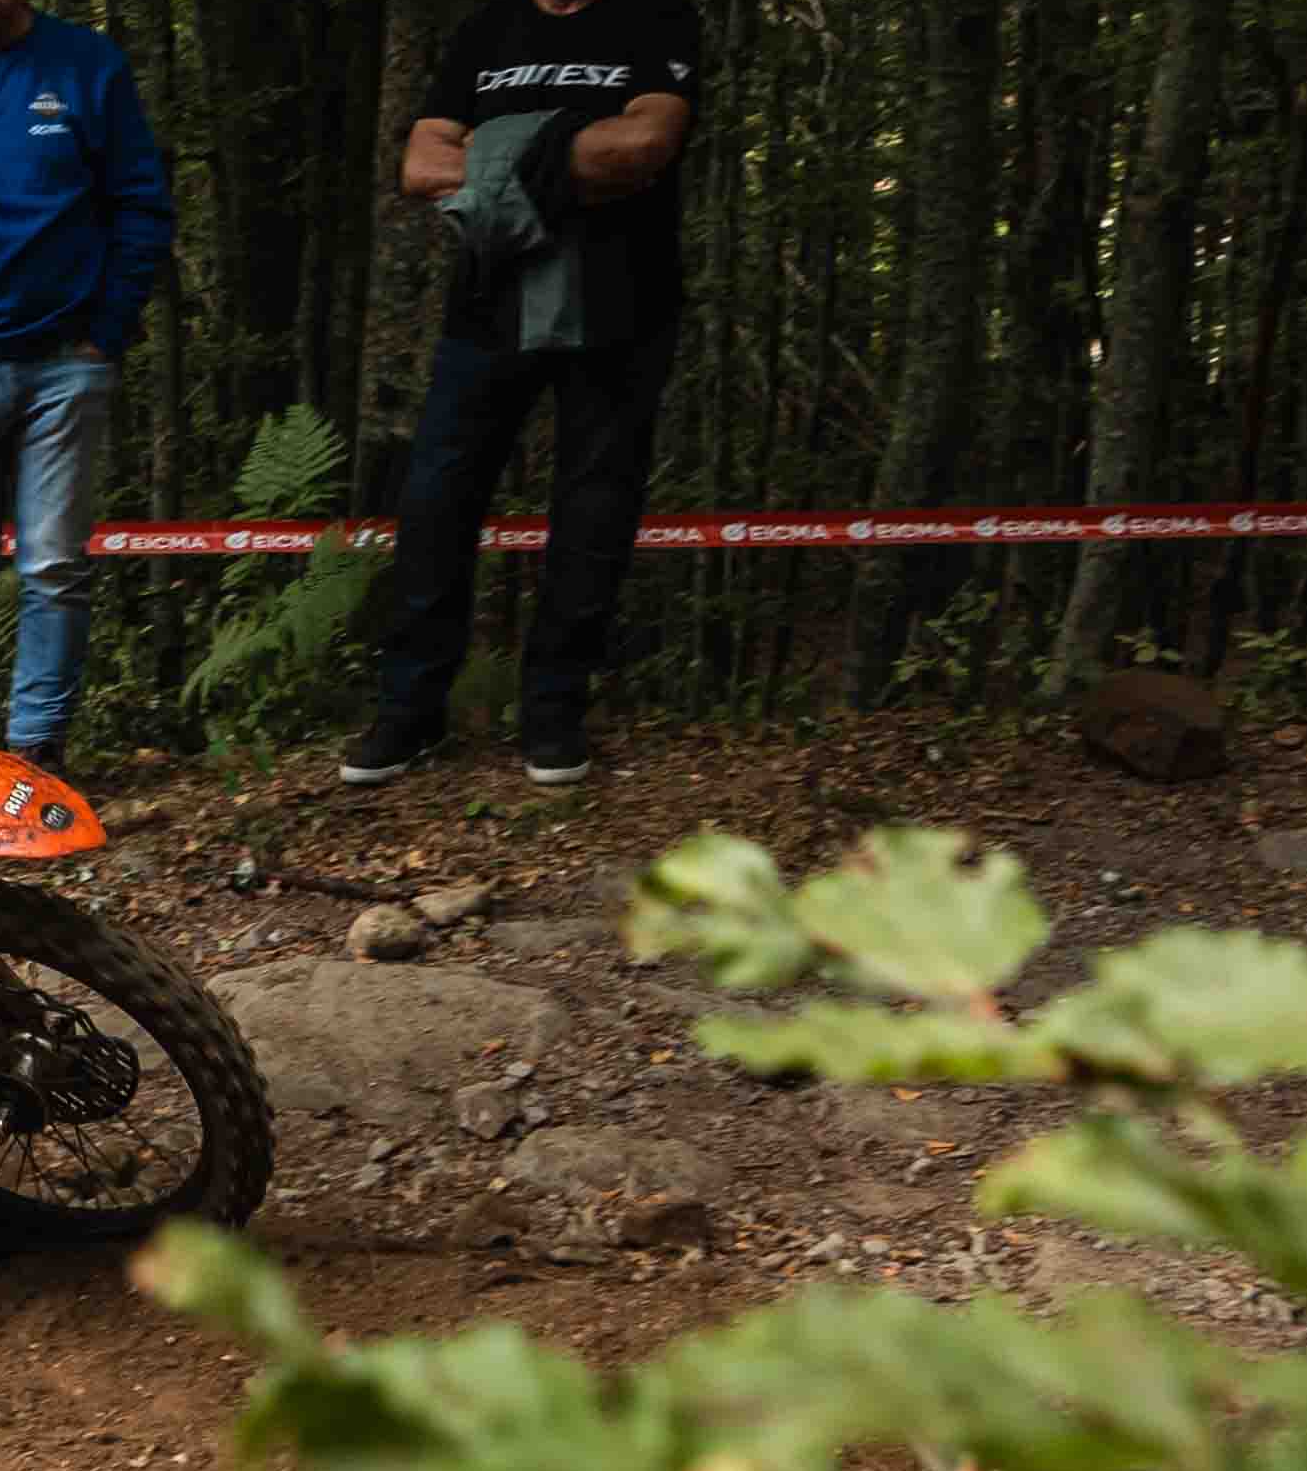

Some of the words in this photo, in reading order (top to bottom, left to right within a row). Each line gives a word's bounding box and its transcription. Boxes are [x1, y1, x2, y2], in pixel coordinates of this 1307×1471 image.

[475, 63, 633, 93] DAINESE
[749, 523, 828, 541] EICMA
[875, 522, 956, 539] EICMA
[1001, 519, 1084, 537] EICMA
[1128, 516, 1211, 534] EICMA
[1257, 515, 1307, 533] EIC
[129, 535, 209, 551] EICMA
[251, 533, 315, 549] EICM
[635, 527, 705, 543] ICMA
[2, 779, 35, 818] RIDE
